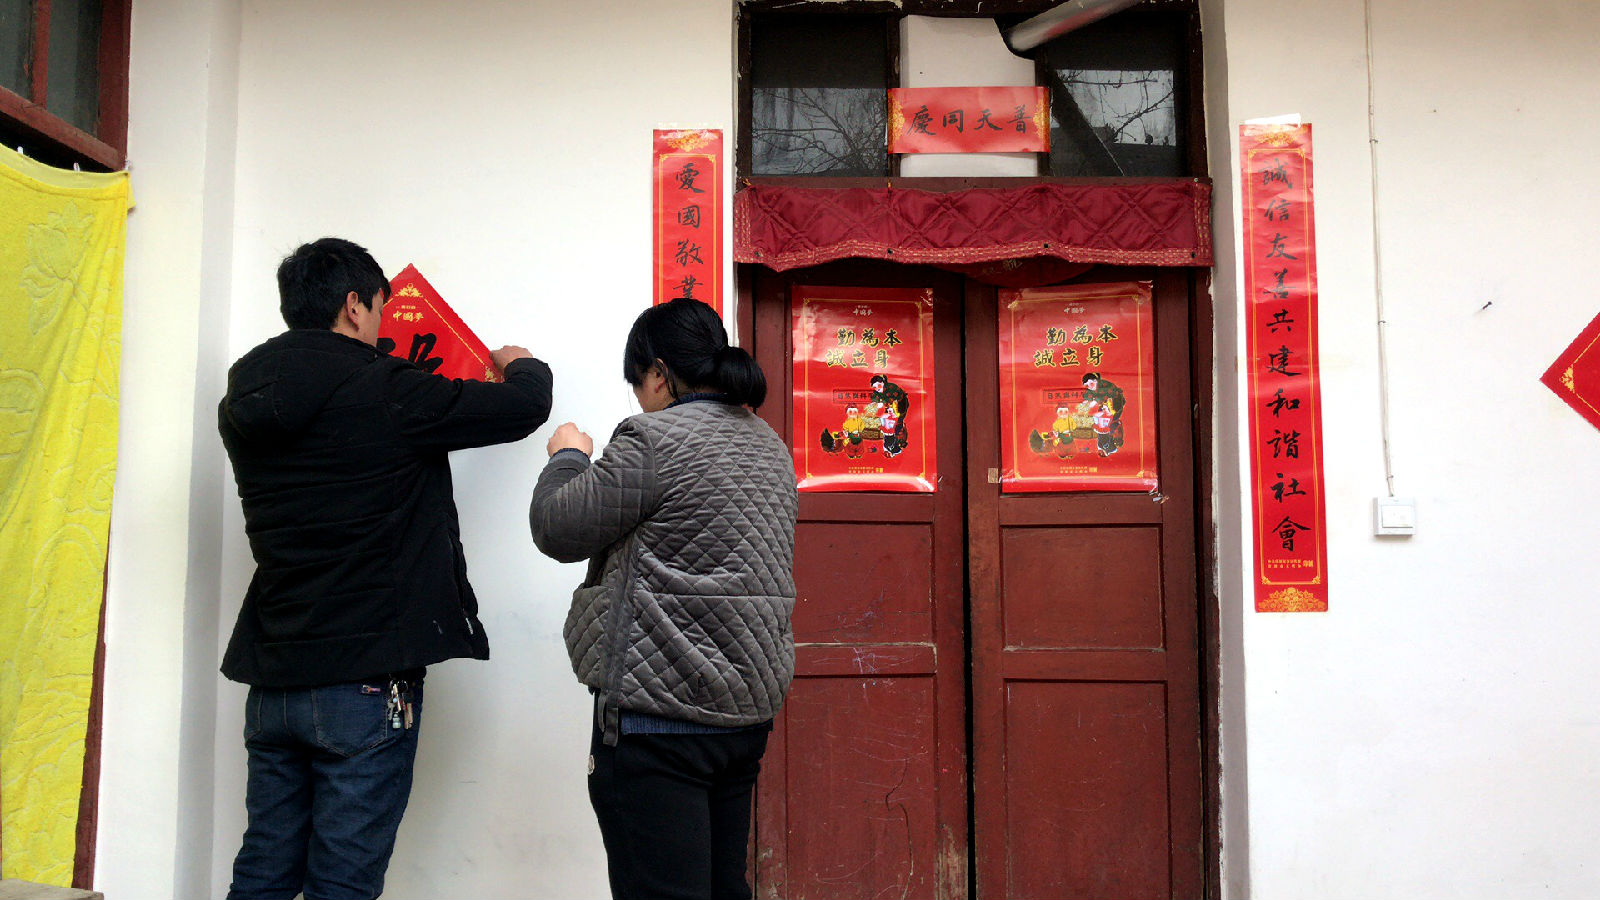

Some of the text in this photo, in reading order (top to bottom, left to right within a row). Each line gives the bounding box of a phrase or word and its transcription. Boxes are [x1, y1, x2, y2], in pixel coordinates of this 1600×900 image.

[835, 327, 903, 348] 勤為本
[1046, 323, 1119, 346] 勤為本
[825, 349, 891, 369] 誠立身
[1033, 346, 1105, 368] 誠立身
[1257, 157, 1311, 552] 誠信友善共建和諧社會
